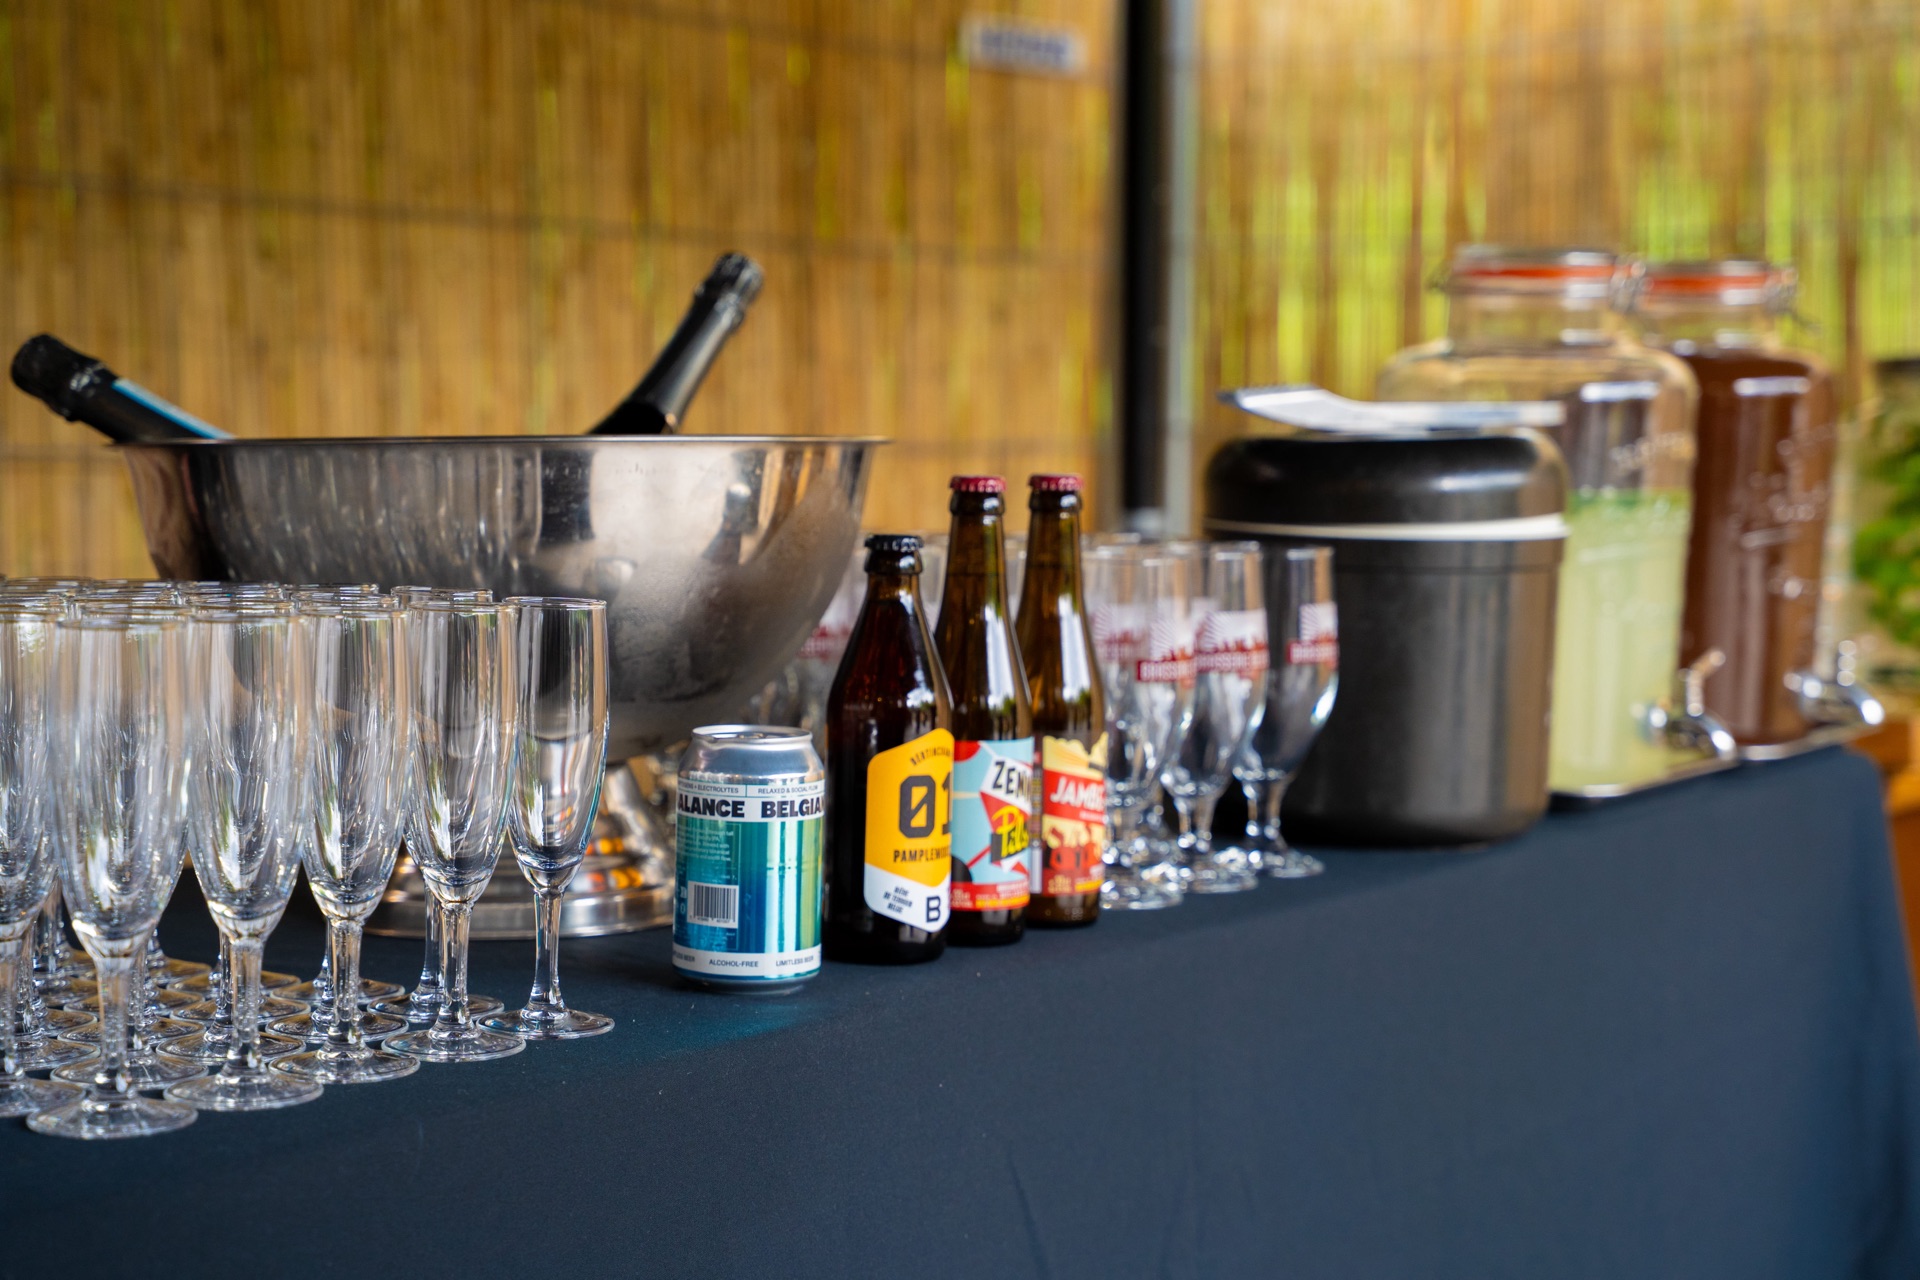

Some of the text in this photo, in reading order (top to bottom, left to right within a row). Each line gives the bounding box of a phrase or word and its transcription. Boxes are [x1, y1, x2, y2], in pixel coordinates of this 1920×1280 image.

[697, 784, 739, 794] ELECTROLYTES
[757, 787, 786, 795] RELAXED
[791, 785, 808, 793] SOCIAL
[926, 895, 941, 923] B
[708, 958, 759, 968] ALCOHOL-FREE
